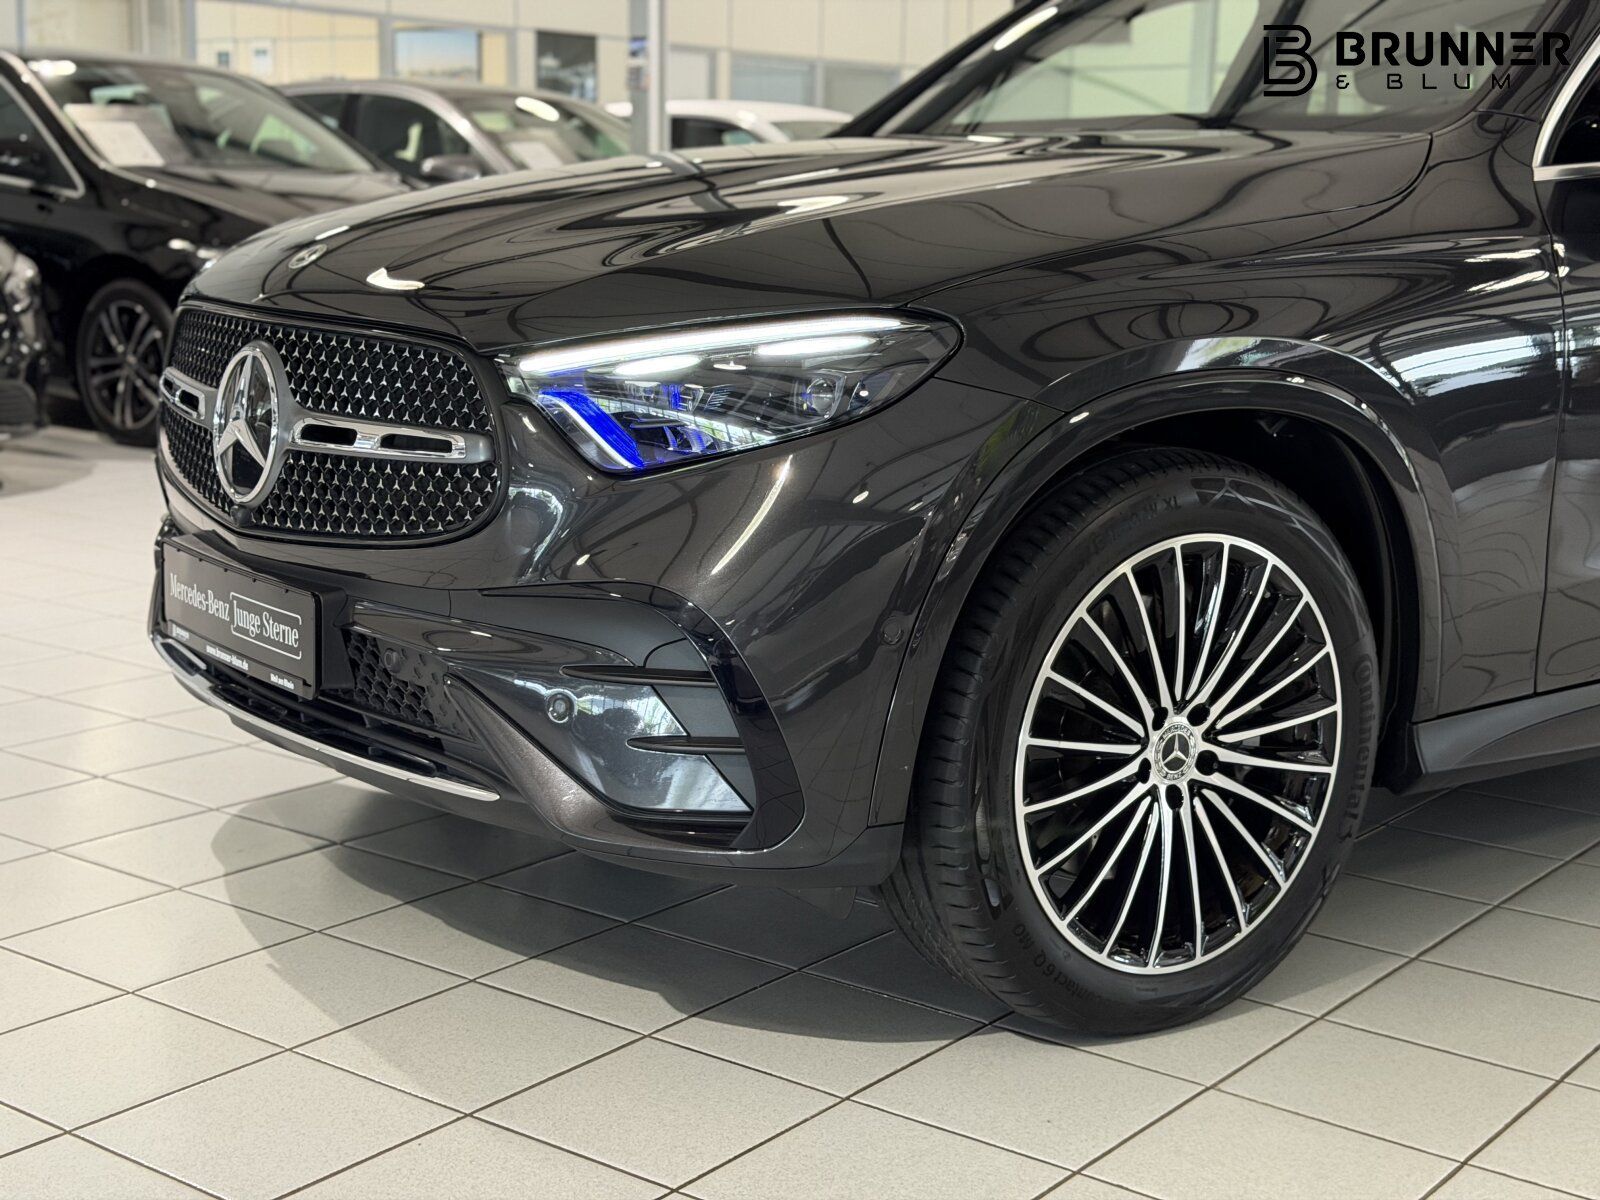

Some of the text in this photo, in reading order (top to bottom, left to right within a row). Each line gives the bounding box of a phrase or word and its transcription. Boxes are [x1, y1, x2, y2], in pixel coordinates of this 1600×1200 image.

[170, 573, 230, 622] Mercedes-Benz
[232, 600, 261, 638] Junge
[262, 611, 299, 648] Sterne
[1345, 653, 1377, 820] Continental
